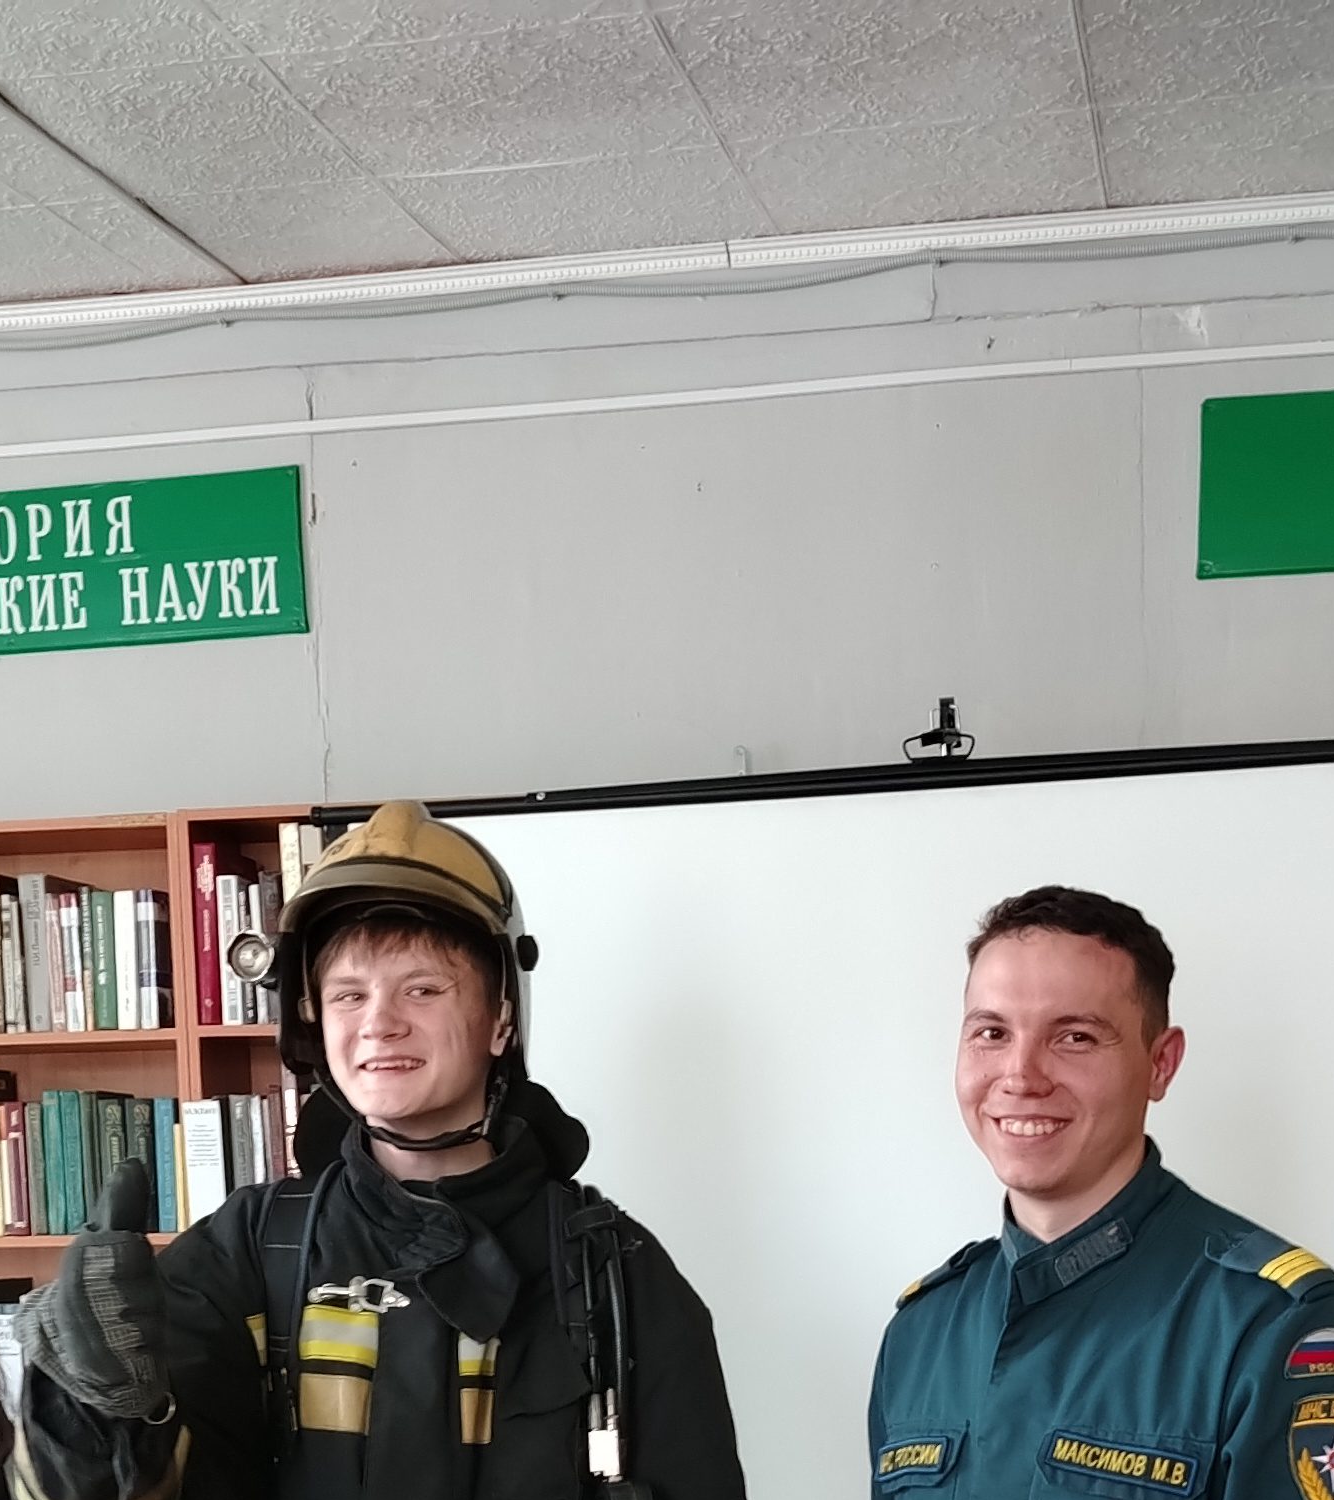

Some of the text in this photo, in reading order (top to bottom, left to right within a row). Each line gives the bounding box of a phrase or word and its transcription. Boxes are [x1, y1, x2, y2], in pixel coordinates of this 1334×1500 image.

[119, 557, 280, 626] НАУКИ
[1298, 1400, 1329, 1420] МЧС
[895, 1443, 942, 1467] РОССИИ
[1053, 1438, 1189, 1487] МАКСИМОВ М.В.
